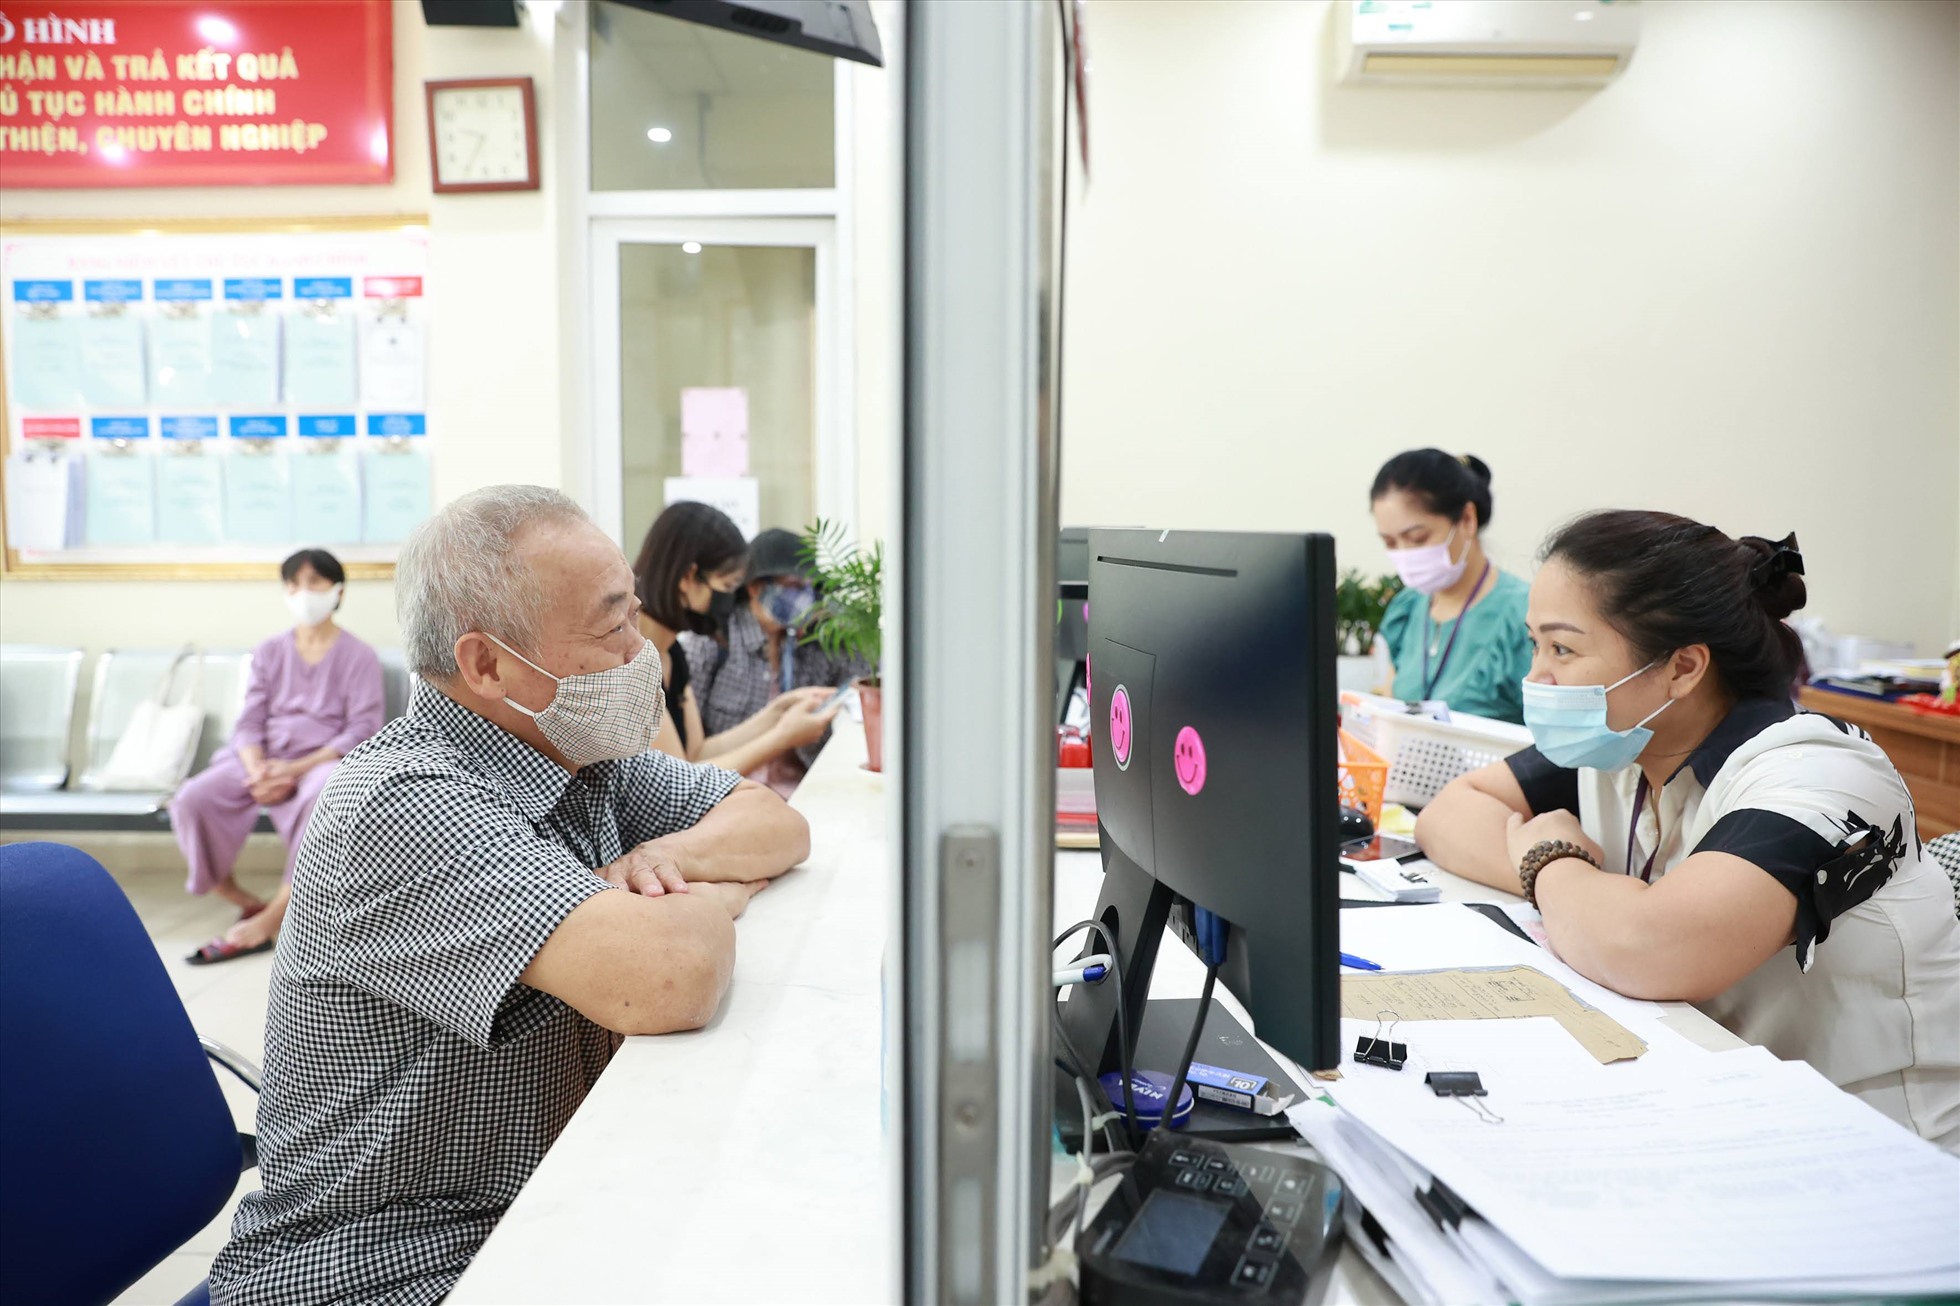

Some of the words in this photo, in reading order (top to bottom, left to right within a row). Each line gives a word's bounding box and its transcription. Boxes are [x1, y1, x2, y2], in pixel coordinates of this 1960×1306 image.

[23, 11, 117, 45] HÌNH
[63, 49, 106, 81] VÀ
[111, 47, 170, 82] TRẢ
[176, 46, 232, 81] KẾT
[236, 46, 299, 82] QUẢ
[26, 90, 87, 121] TỤC
[94, 84, 176, 117] HÀNH
[182, 83, 276, 116] CHÍNH
[96, 120, 212, 152] CHUYÊN
[219, 118, 328, 155] NGHIỆP
[1118, 1079, 1163, 1100] NIV
